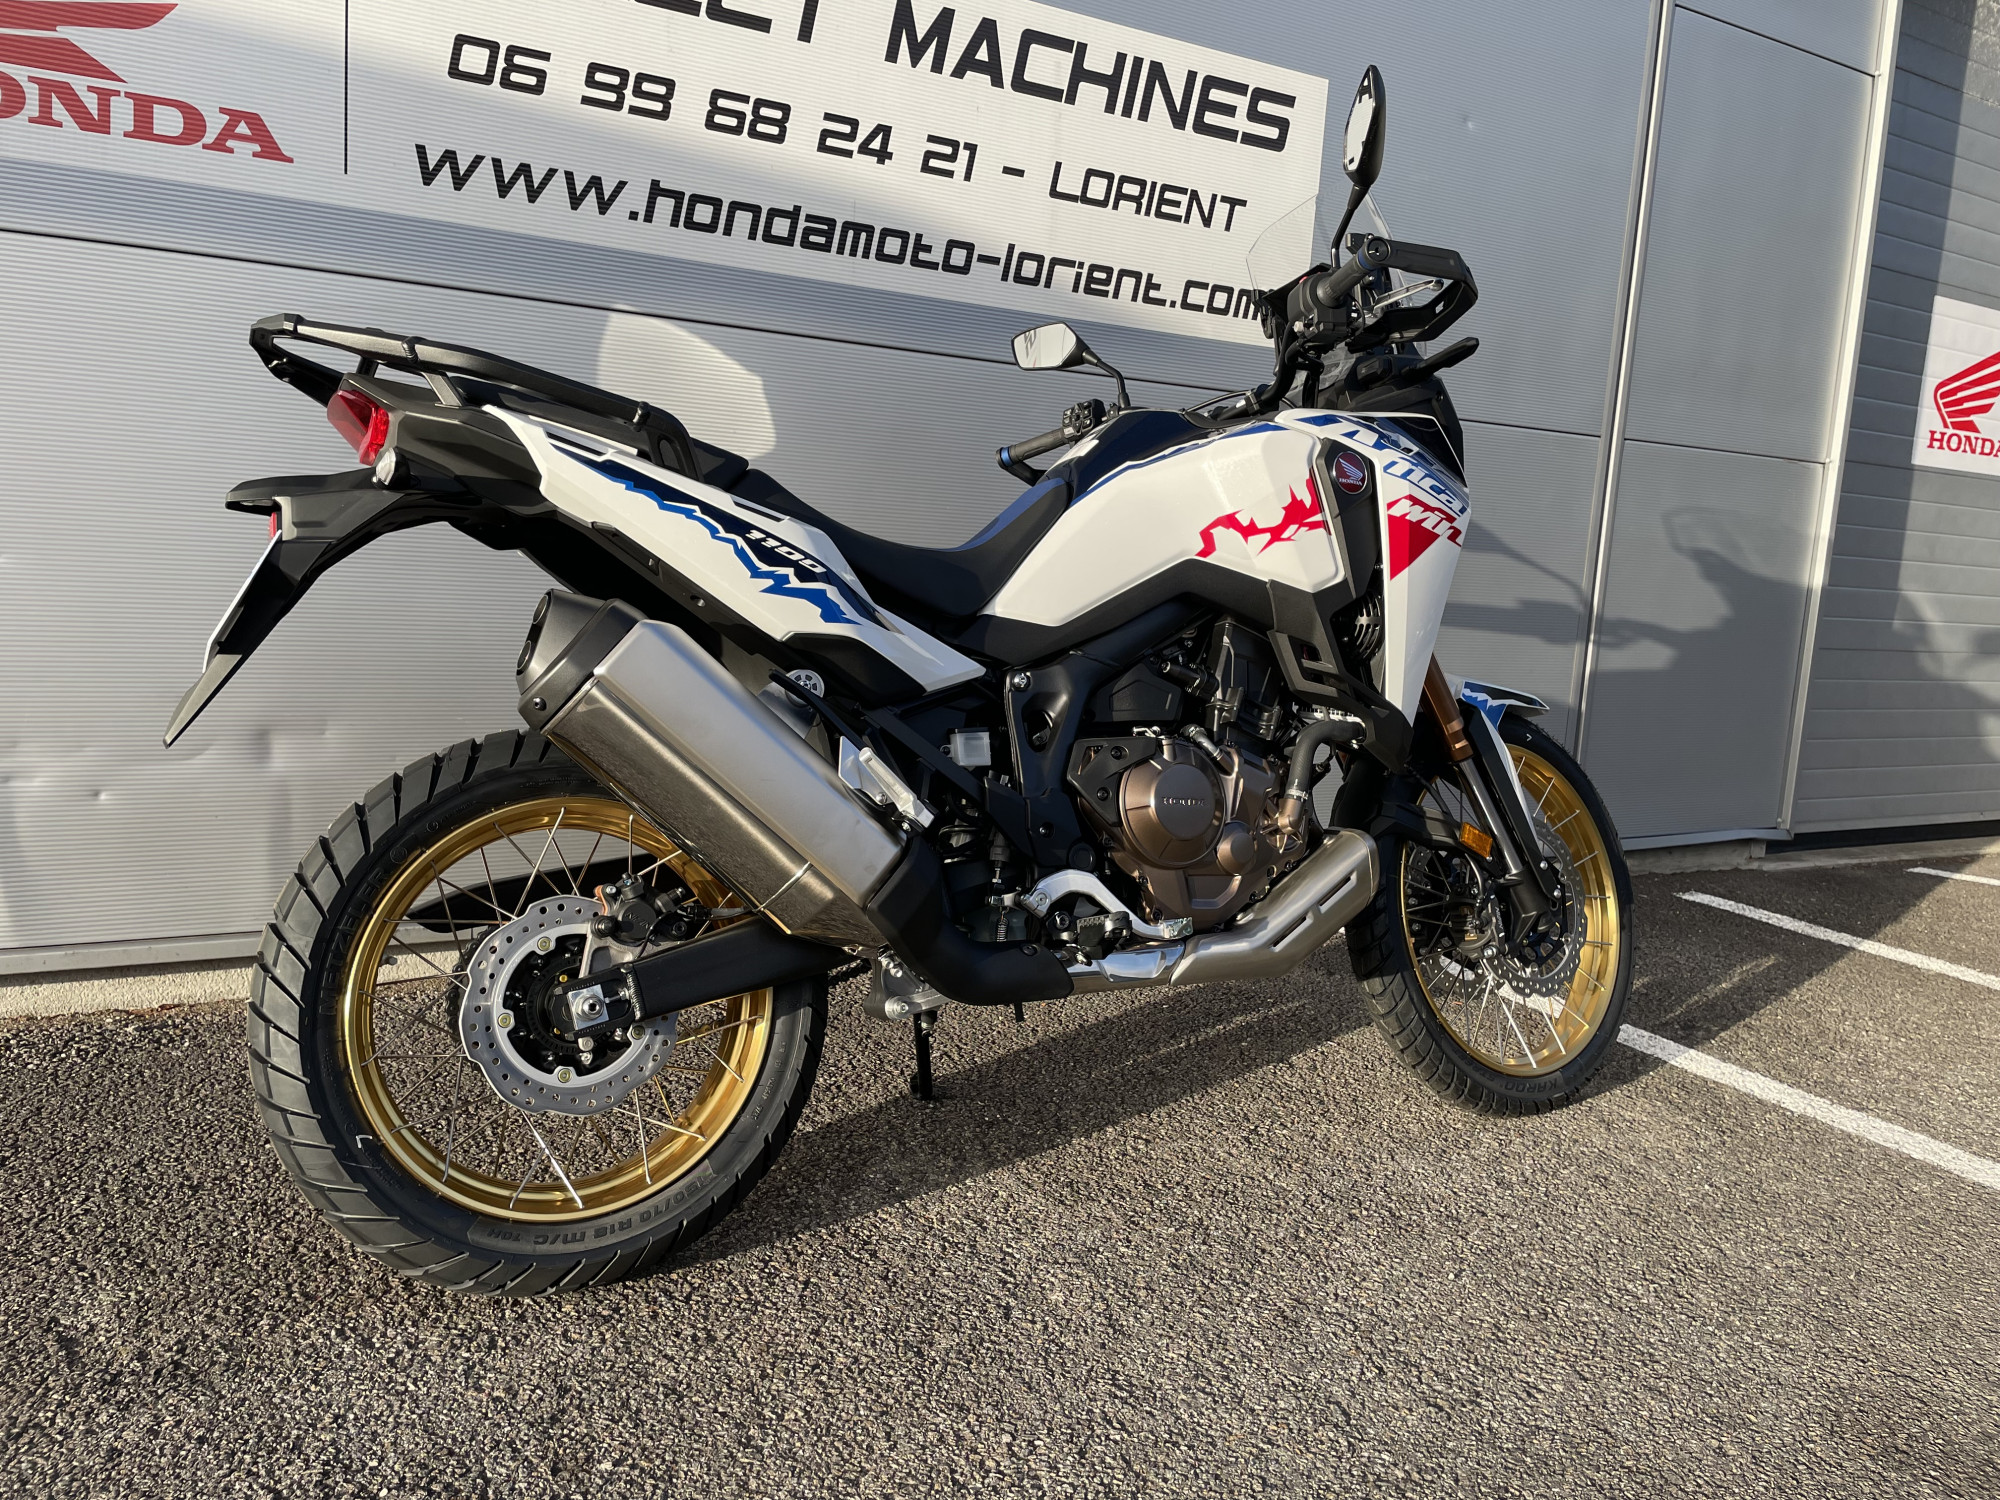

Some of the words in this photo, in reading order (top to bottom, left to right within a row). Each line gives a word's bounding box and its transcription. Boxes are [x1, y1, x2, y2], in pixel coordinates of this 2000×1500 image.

[884, 2, 1296, 153] MACHINES
[447, 33, 551, 95] 06
[580, 61, 676, 122] 99
[705, 87, 791, 145] 68
[816, 112, 893, 165] 24
[919, 134, 978, 182] 21
[1048, 160, 1247, 233] LORIENT
[414, 143, 1260, 321] www.hondamoto-lorient.com
[1339, 477, 1363, 486] HONDA
[745, 529, 827, 574] 1100
[318, 866, 386, 1015] METZELER
[1504, 1078, 1558, 1092] KAROO
[532, 1231, 586, 1246] M/C
